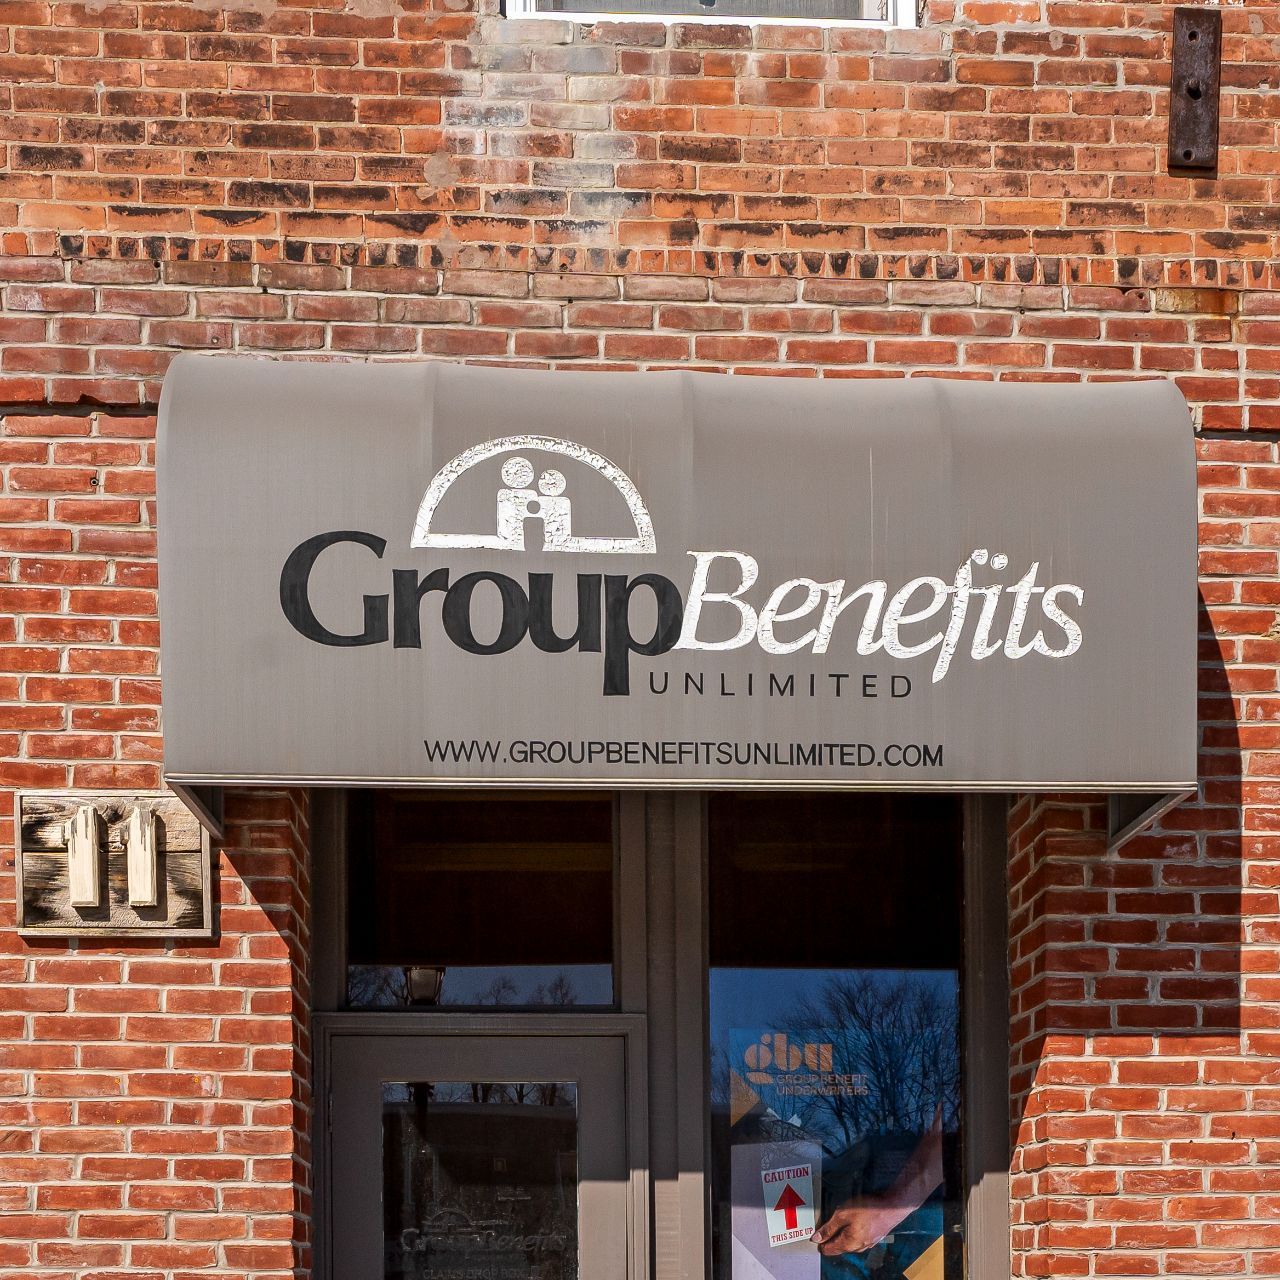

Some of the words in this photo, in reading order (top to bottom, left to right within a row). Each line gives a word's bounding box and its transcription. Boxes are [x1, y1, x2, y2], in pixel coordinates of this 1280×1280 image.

[279, 530, 684, 697] Group
[672, 548, 1086, 685] Benefits
[648, 671, 913, 699] UNLIMITED
[423, 738, 945, 768] WWW.GROUPBENEFITSUNLIMITED.COM
[764, 1166, 809, 1184] CAUTION
[771, 1232, 788, 1243] THIS
[788, 1229, 804, 1239] SIDE
[804, 1226, 814, 1236] UP
